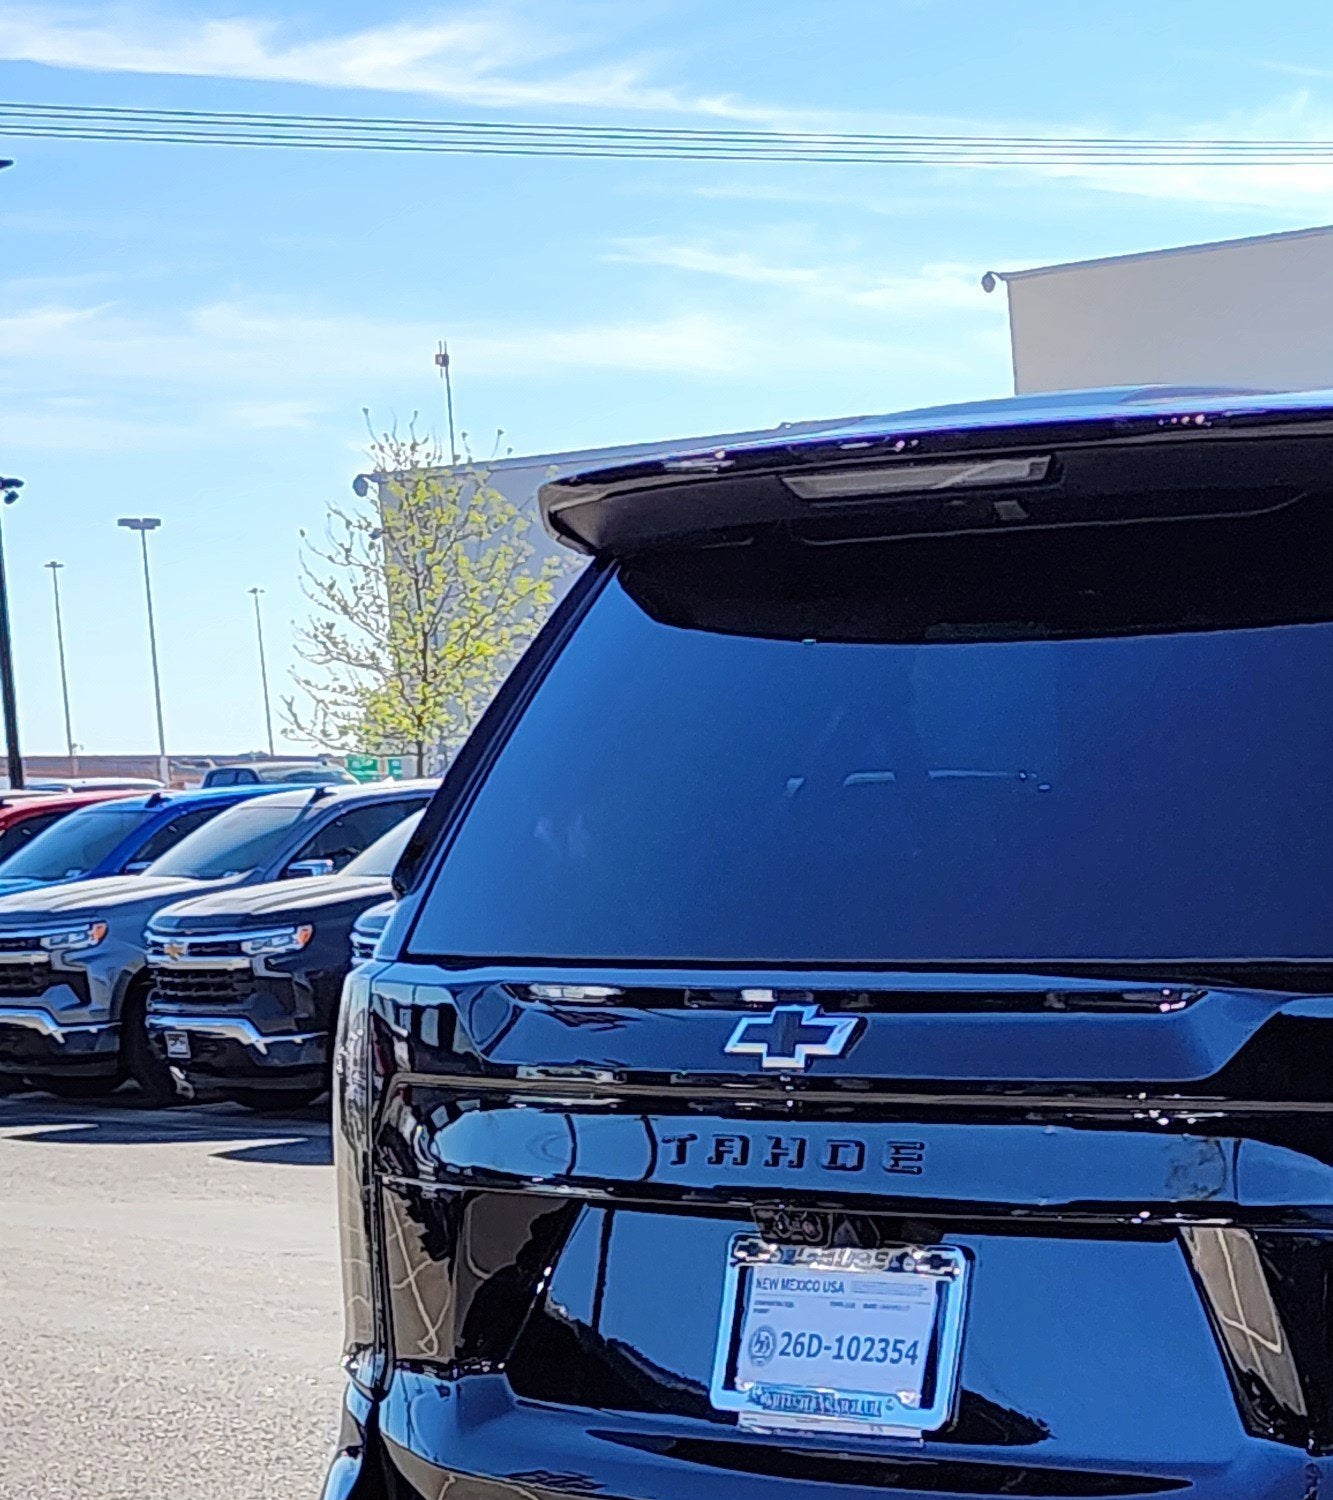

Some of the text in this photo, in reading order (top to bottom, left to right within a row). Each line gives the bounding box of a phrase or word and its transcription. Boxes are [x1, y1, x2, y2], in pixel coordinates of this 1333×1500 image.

[661, 1132, 926, 1176] TAHOE
[755, 1277, 779, 1291] NEW
[780, 1278, 820, 1294] MEXICO
[822, 1280, 845, 1294] USA
[778, 1330, 920, 1366] 26D-102354
